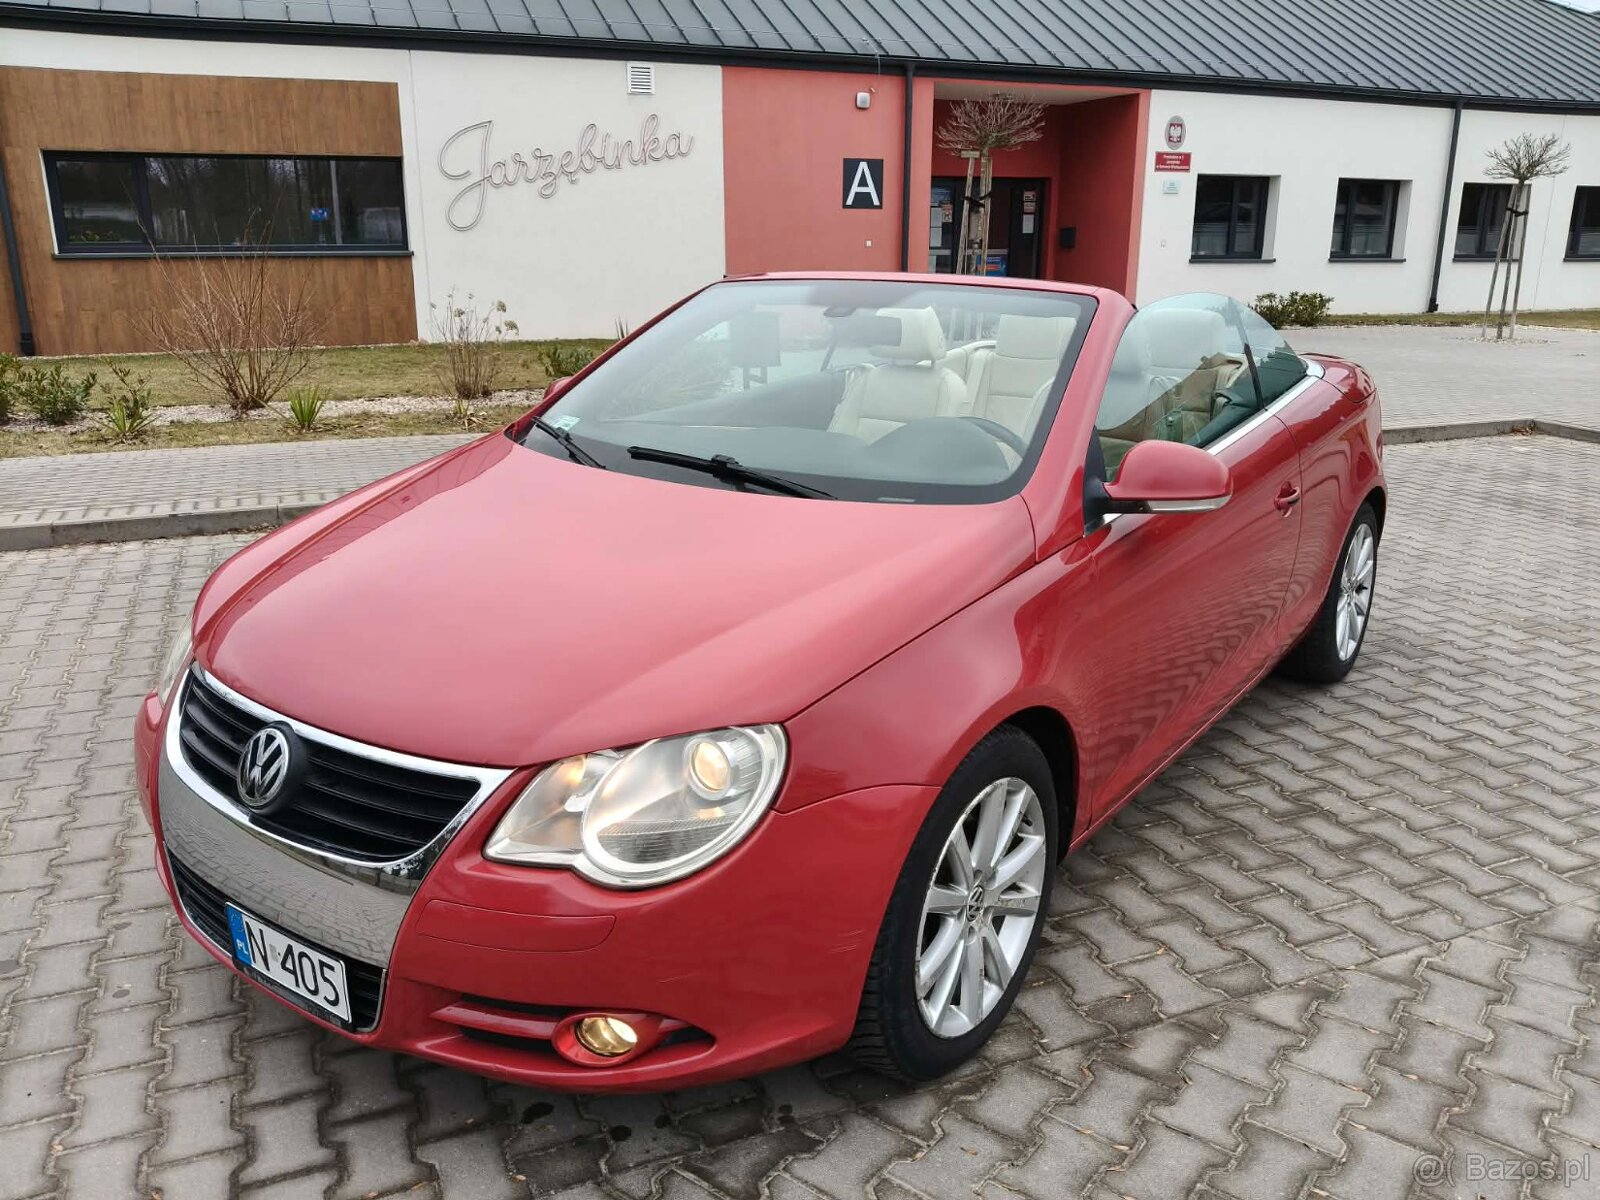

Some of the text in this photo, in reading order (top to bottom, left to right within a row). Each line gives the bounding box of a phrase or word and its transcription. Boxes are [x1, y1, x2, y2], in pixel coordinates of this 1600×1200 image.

[437, 113, 694, 232] Jarzębinka
[845, 161, 881, 206] A
[244, 920, 341, 1007] N 405
